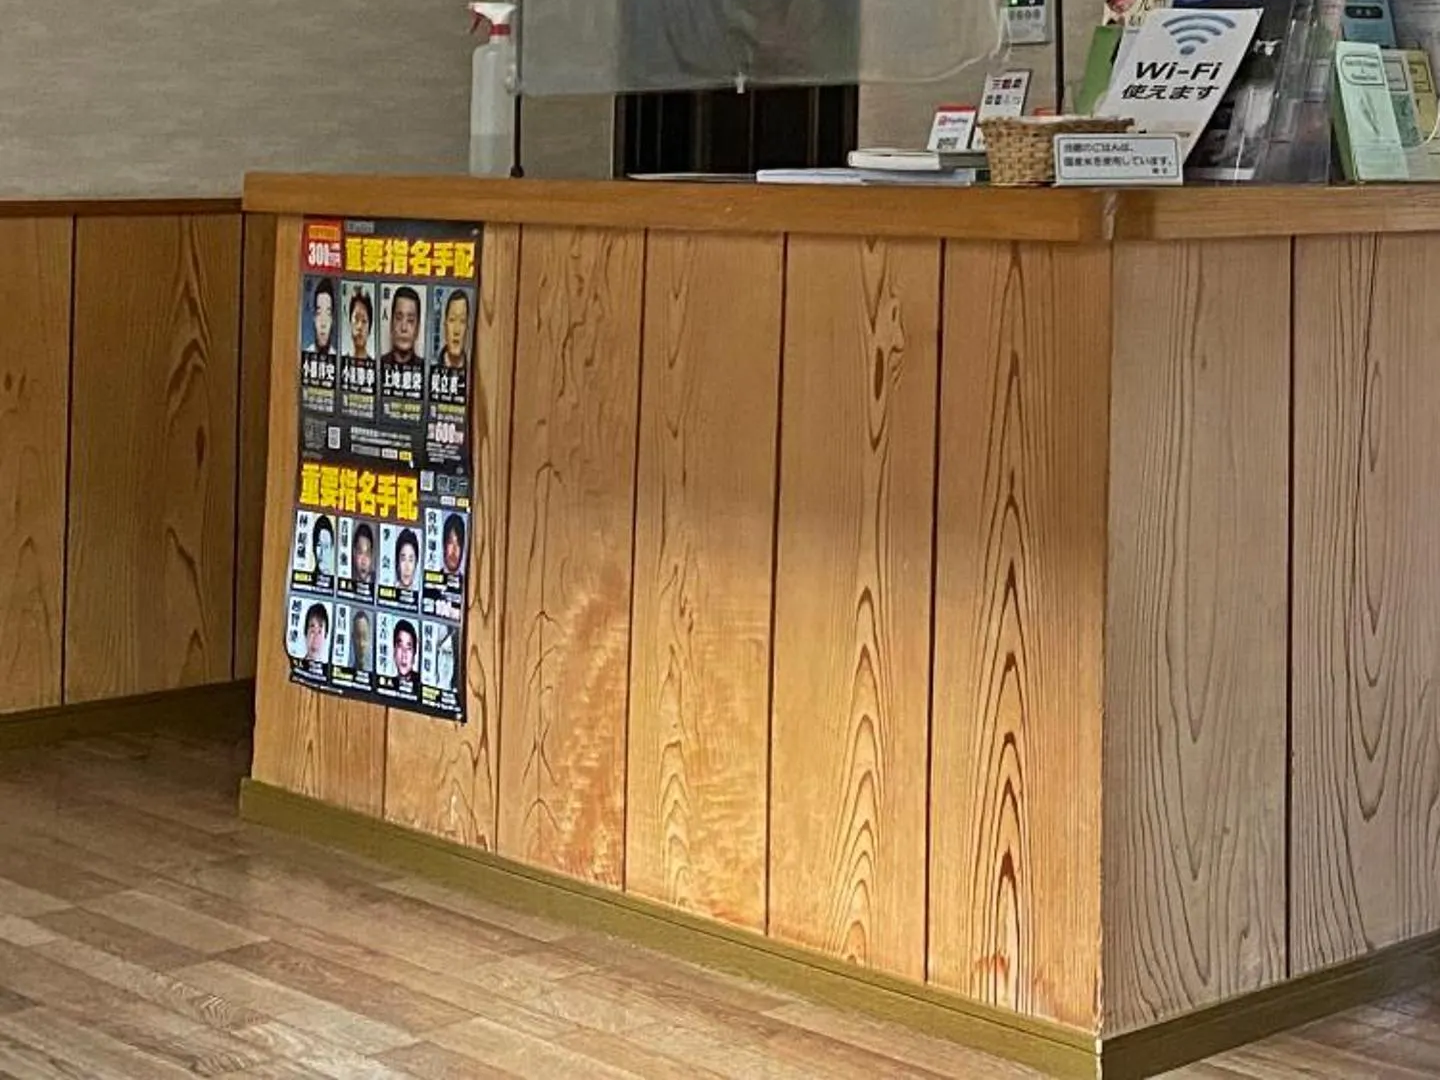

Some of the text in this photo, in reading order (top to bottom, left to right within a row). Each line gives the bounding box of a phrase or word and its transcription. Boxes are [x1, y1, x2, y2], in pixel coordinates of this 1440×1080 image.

[1135, 61, 1223, 81] Wi-Fi
[1121, 84, 1220, 101] 使えます
[344, 236, 476, 279] 重要指名手配
[300, 463, 418, 522] 重要指名手配
